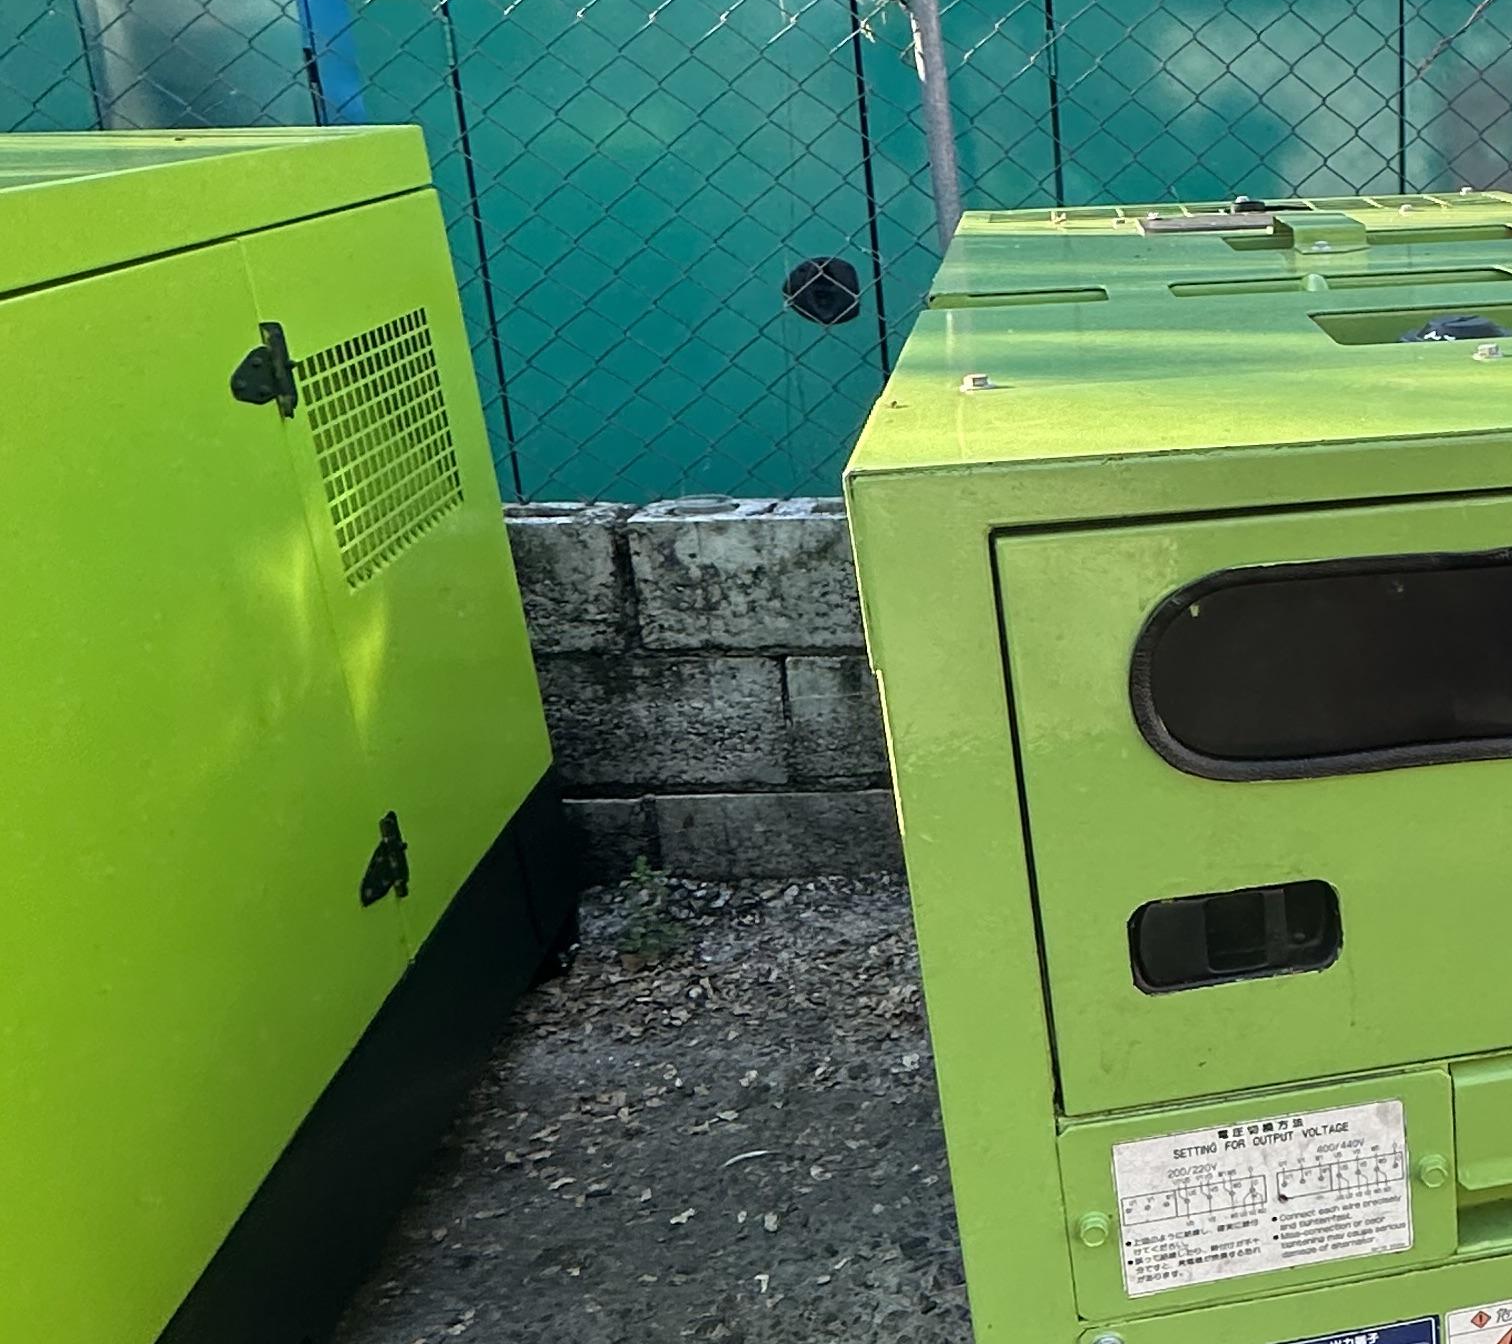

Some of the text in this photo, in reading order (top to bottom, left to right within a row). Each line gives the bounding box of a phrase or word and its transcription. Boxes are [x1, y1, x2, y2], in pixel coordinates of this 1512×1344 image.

[1173, 1122, 1349, 1159] SETTING FOR OUTPUT VOLTAGE
